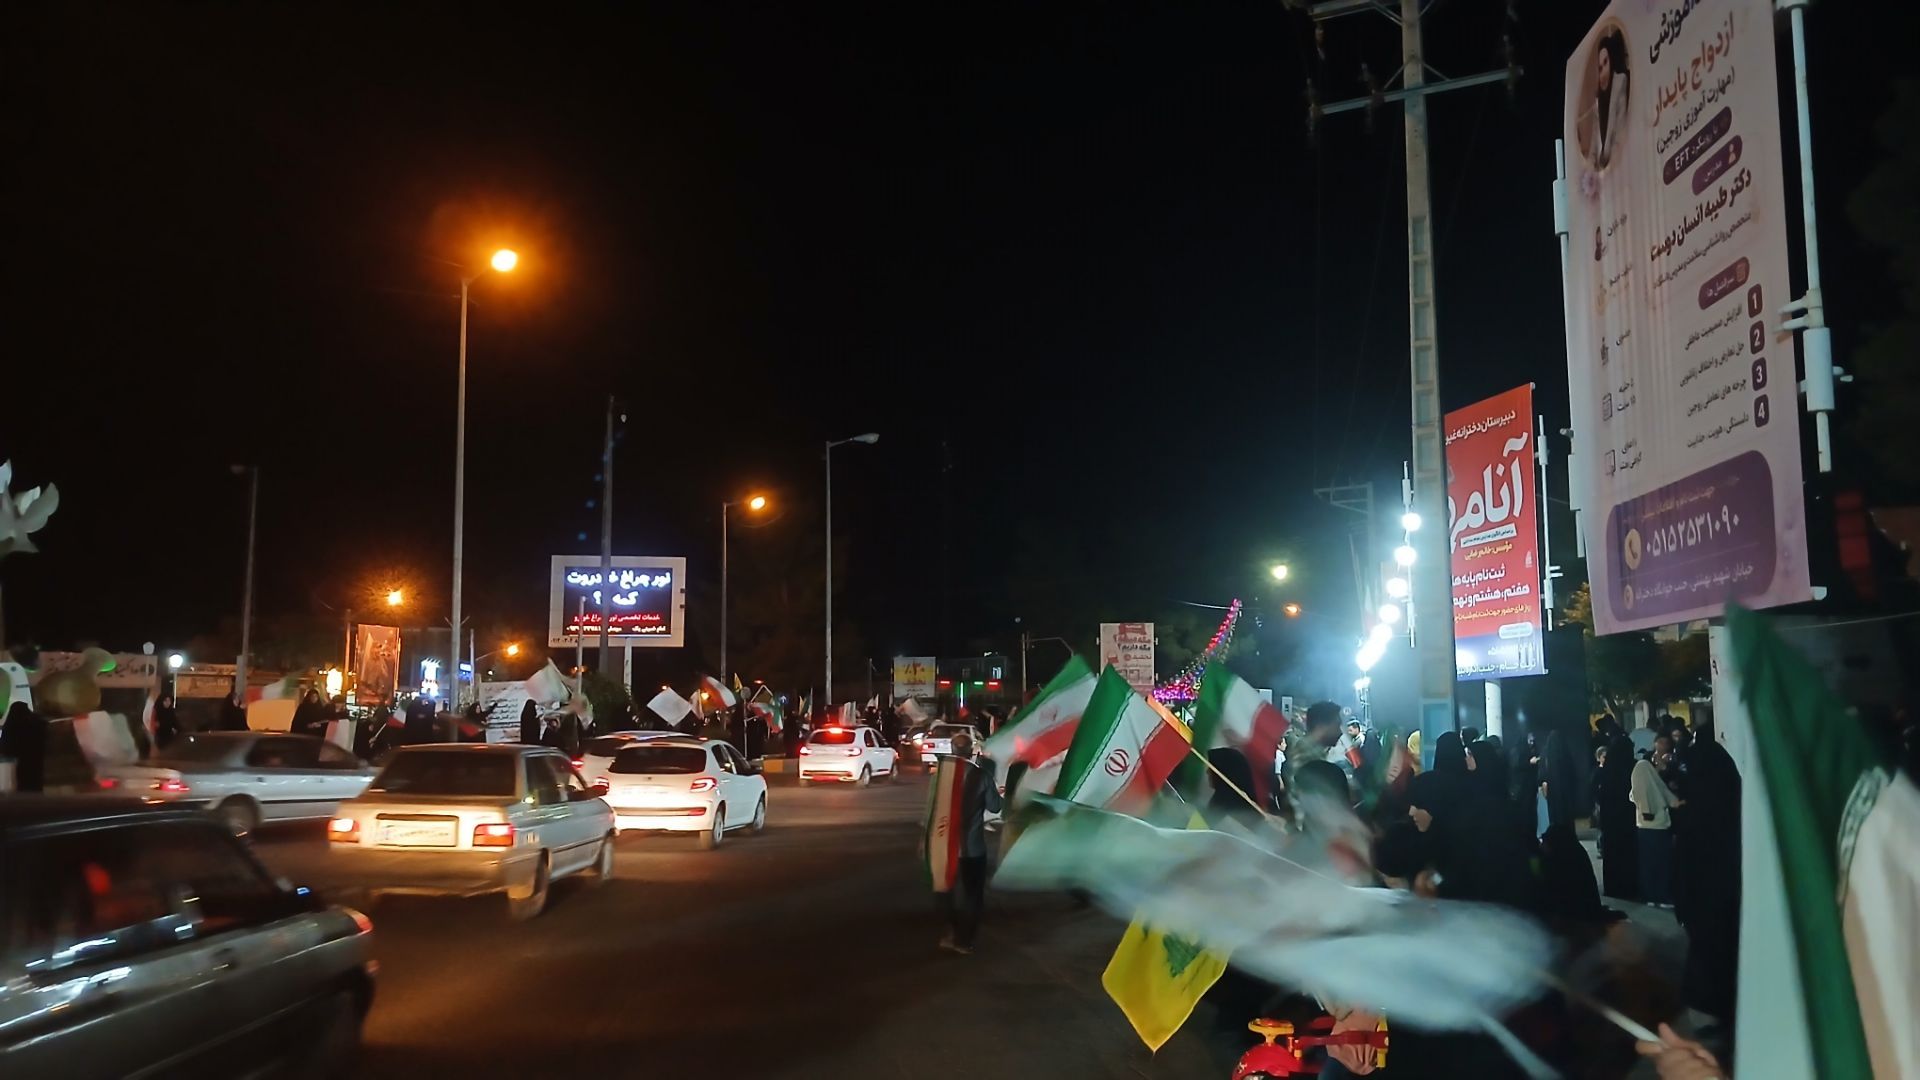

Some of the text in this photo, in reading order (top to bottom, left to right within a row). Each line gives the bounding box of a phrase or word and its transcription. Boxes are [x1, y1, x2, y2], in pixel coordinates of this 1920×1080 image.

[1650, 0, 1695, 65] موزشی
[1652, 10, 1735, 128] ازدواج پایدار
[1674, 146, 1691, 171] EFT
[1650, 167, 1752, 262] دکتر طیبه انسان دوست
[1455, 421, 1482, 441] دخترانه
[1480, 409, 1516, 434] دبیرستان
[1646, 504, 1740, 558] ۰۵۱۵۲۵۳۱۰۹۰
[620, 570, 650, 589] چراغ
[651, 572, 671, 587] نور
[1489, 562, 1506, 582] ثبت
[1712, 567, 1731, 585] شهید
[1731, 560, 1754, 583] خیابان
[612, 590, 639, 606] کمه
[1473, 586, 1502, 606] هشتم
[617, 614, 642, 623] تخصصی
[641, 614, 661, 622] خدمات
